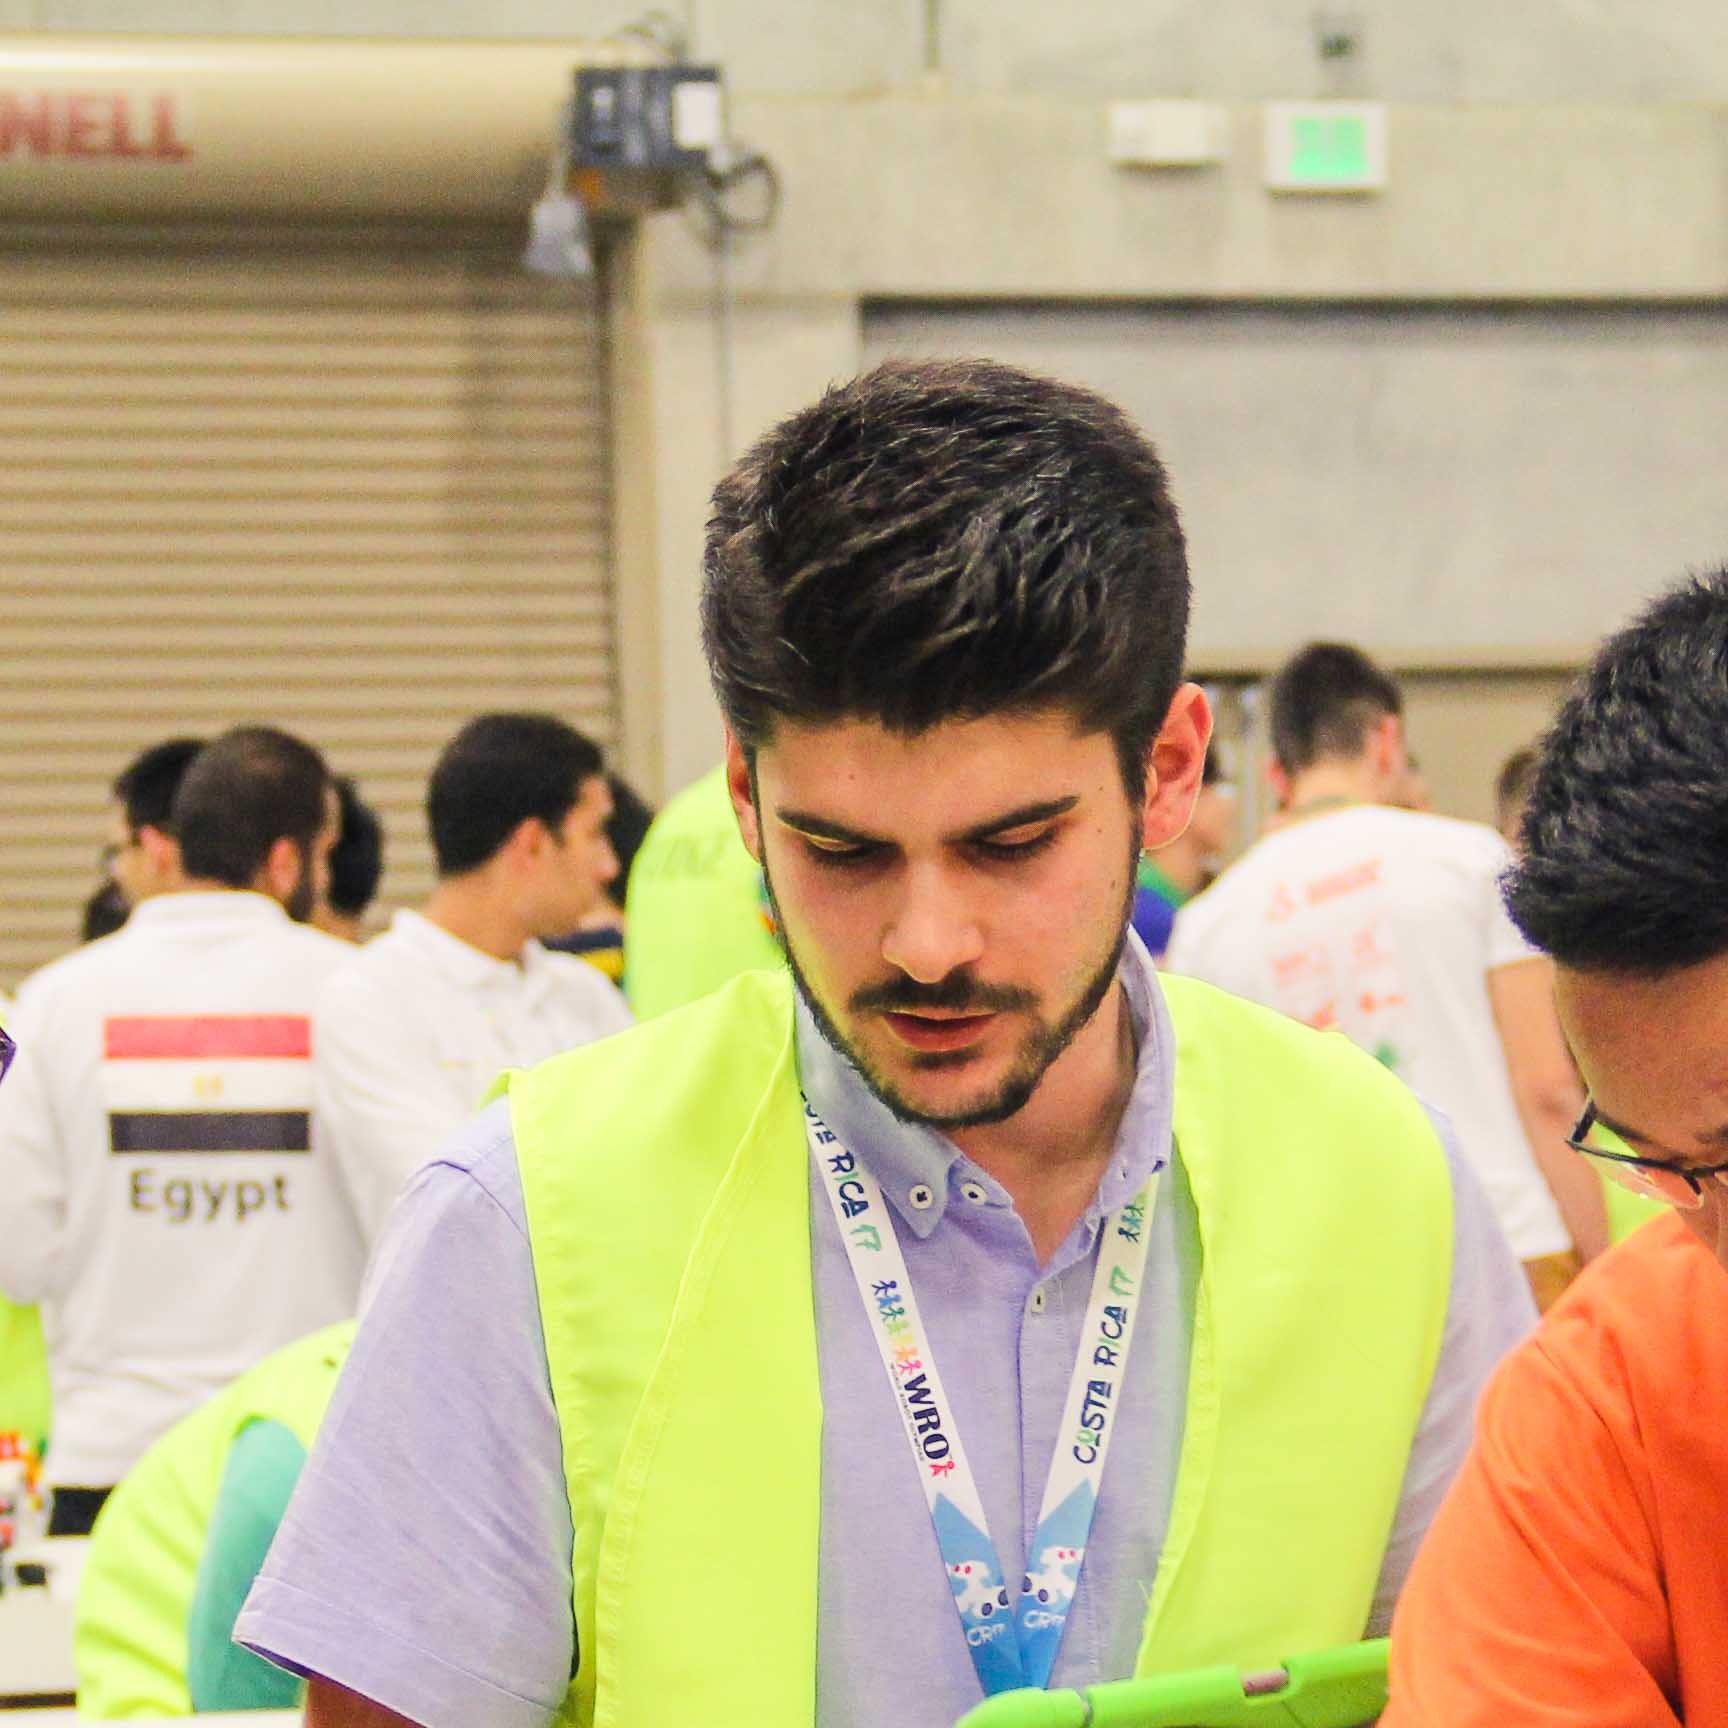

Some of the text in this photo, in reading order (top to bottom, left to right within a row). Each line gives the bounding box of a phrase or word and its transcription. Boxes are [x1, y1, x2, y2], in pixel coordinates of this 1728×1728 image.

[129, 1168, 291, 1225] Egypt
[828, 1150, 870, 1219] RICA
[904, 1373, 949, 1459] WRO
[1073, 1380, 1113, 1464] COSTA
[1093, 1305, 1128, 1367] RICA
